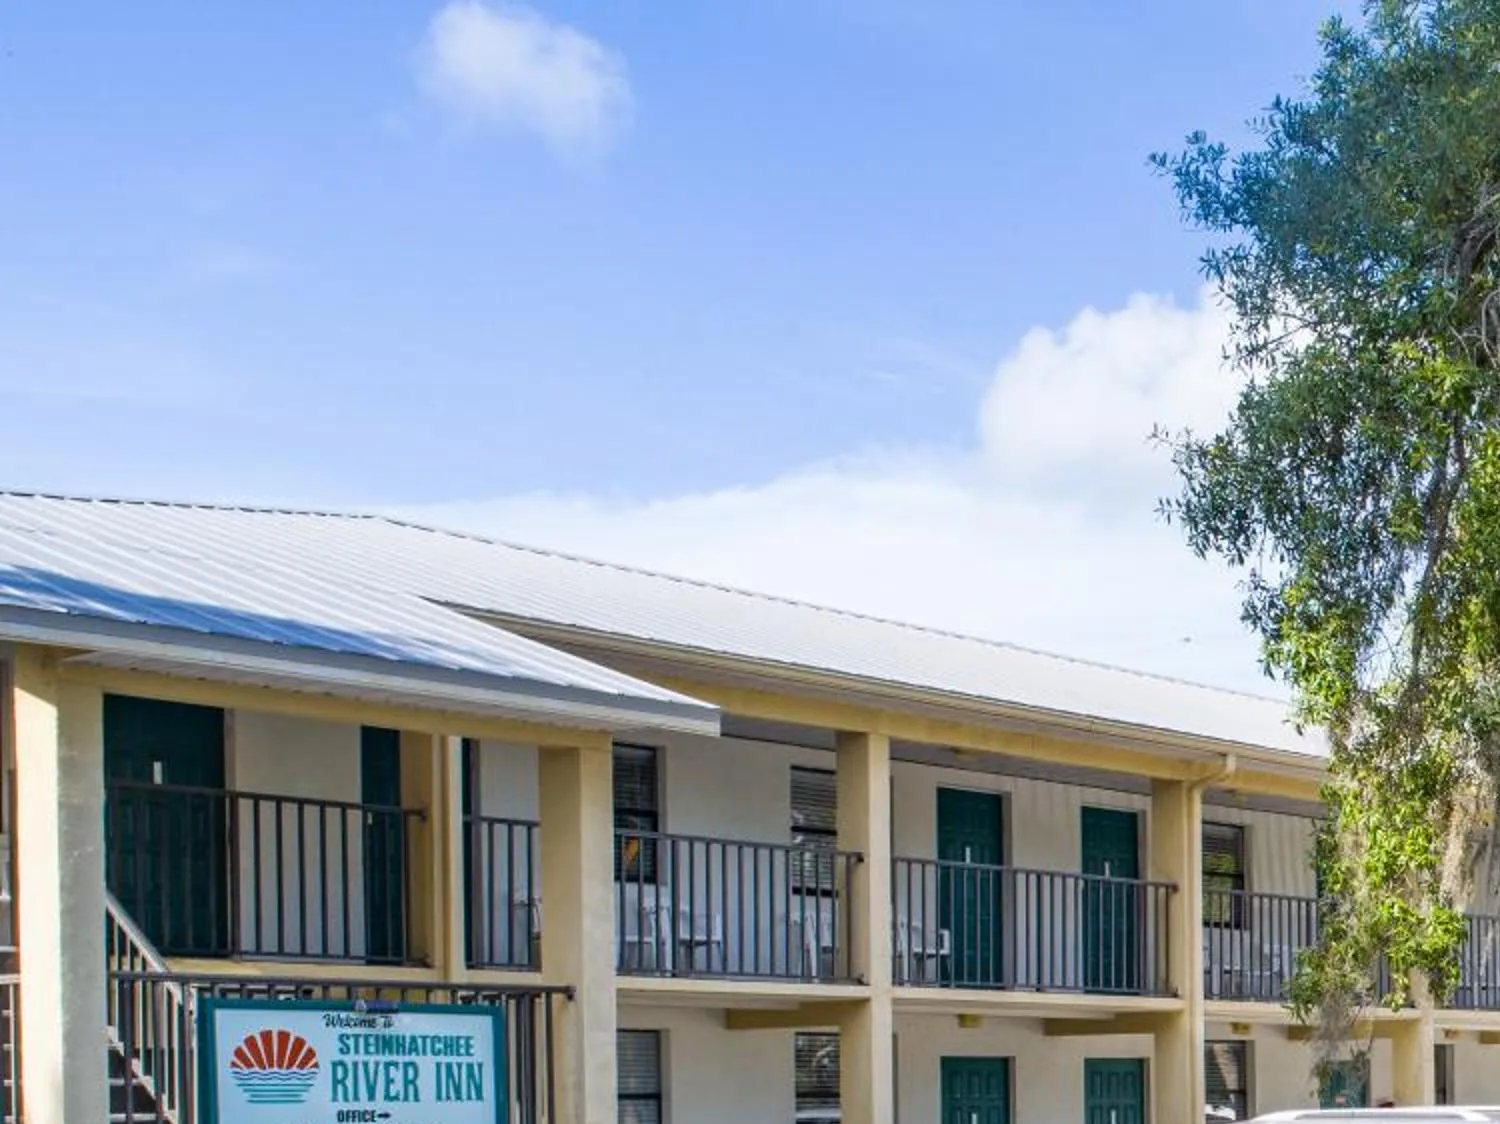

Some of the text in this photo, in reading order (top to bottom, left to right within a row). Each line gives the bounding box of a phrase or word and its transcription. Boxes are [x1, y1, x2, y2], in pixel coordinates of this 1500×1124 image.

[338, 1033, 475, 1056] STEINHATCHEE
[331, 1061, 484, 1102] RIVER INN
[336, 1109, 377, 1123] OFFICE
